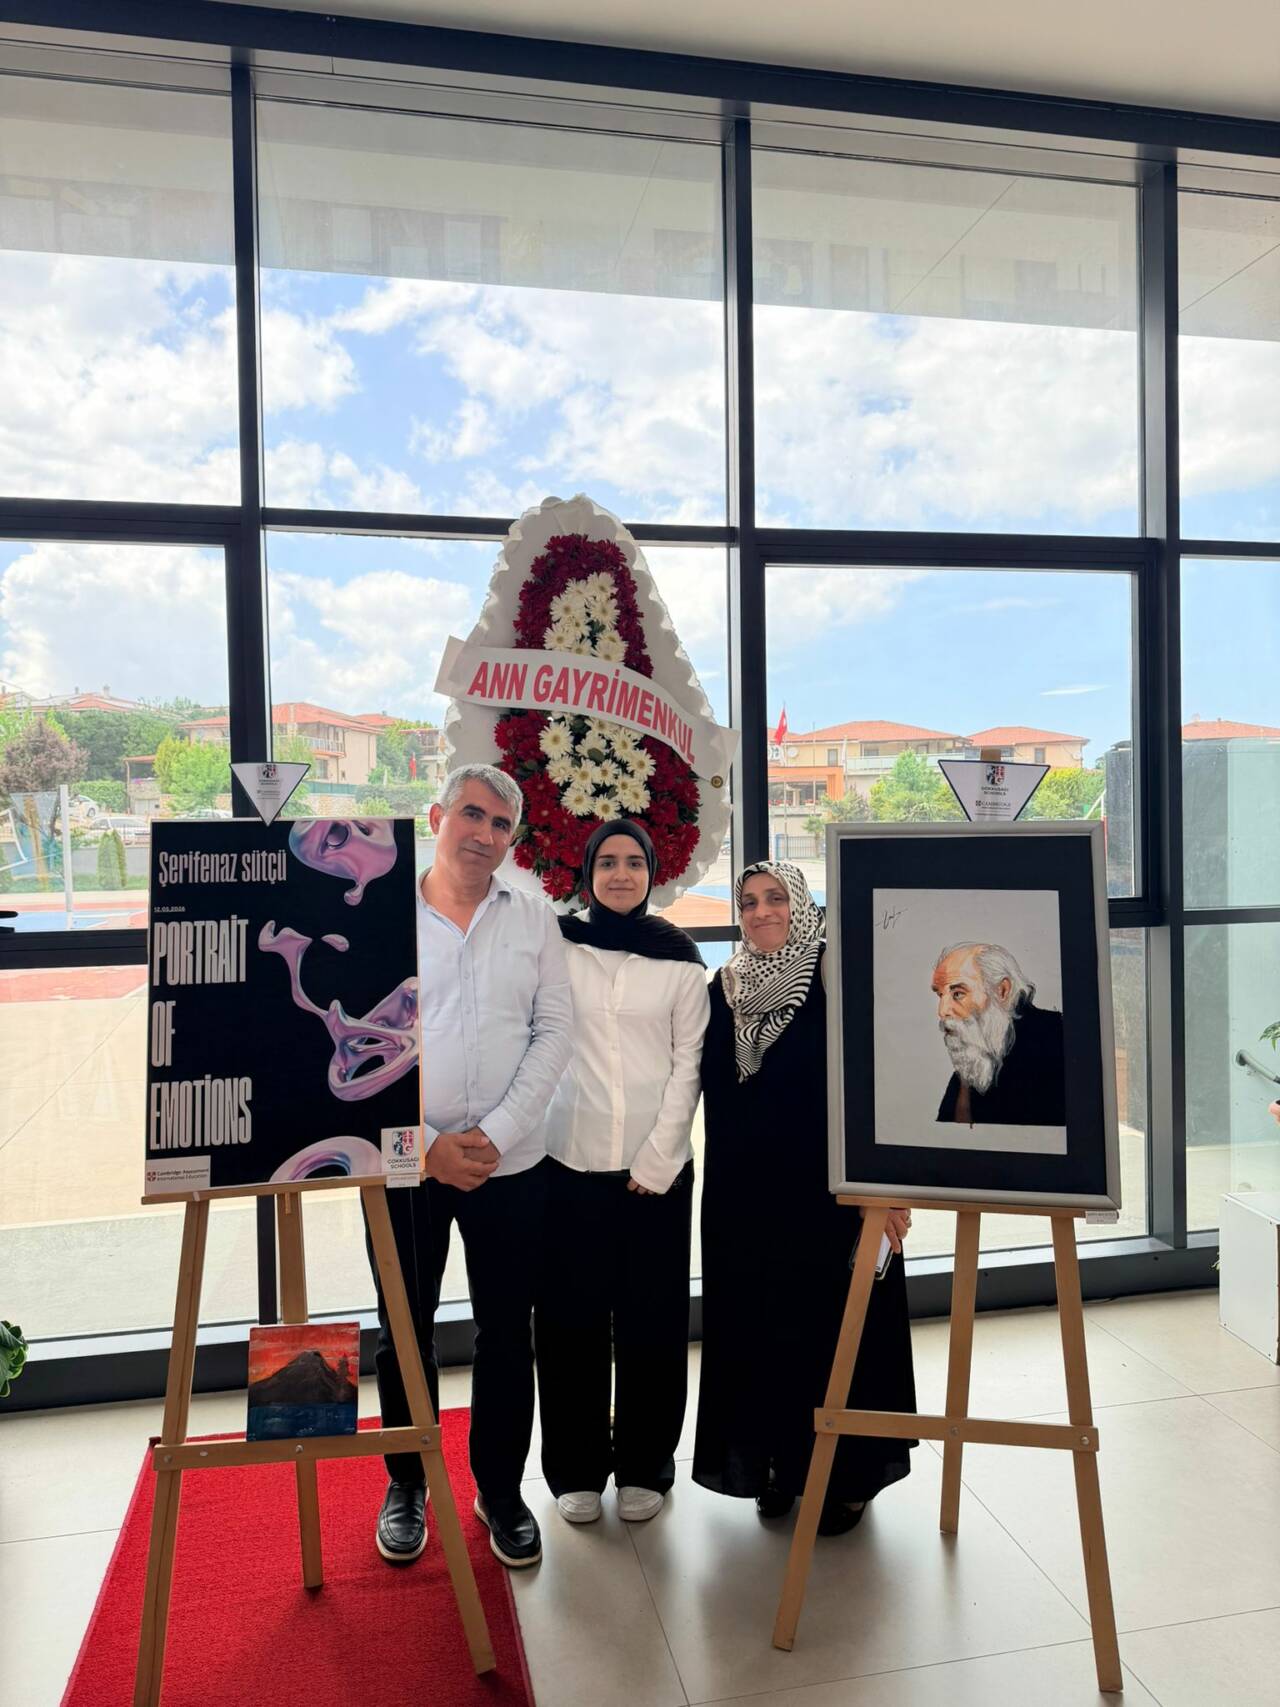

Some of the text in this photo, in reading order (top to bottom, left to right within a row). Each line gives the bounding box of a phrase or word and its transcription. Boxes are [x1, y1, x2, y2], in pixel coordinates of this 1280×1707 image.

[467, 661, 697, 764] ANN GAYRİMENKUL
[159, 850, 287, 887] Şerifenaz sütçü
[152, 914, 249, 987] PORTRAİT
[151, 1000, 177, 1068] OF
[149, 1074, 253, 1150] EMOTİONS
